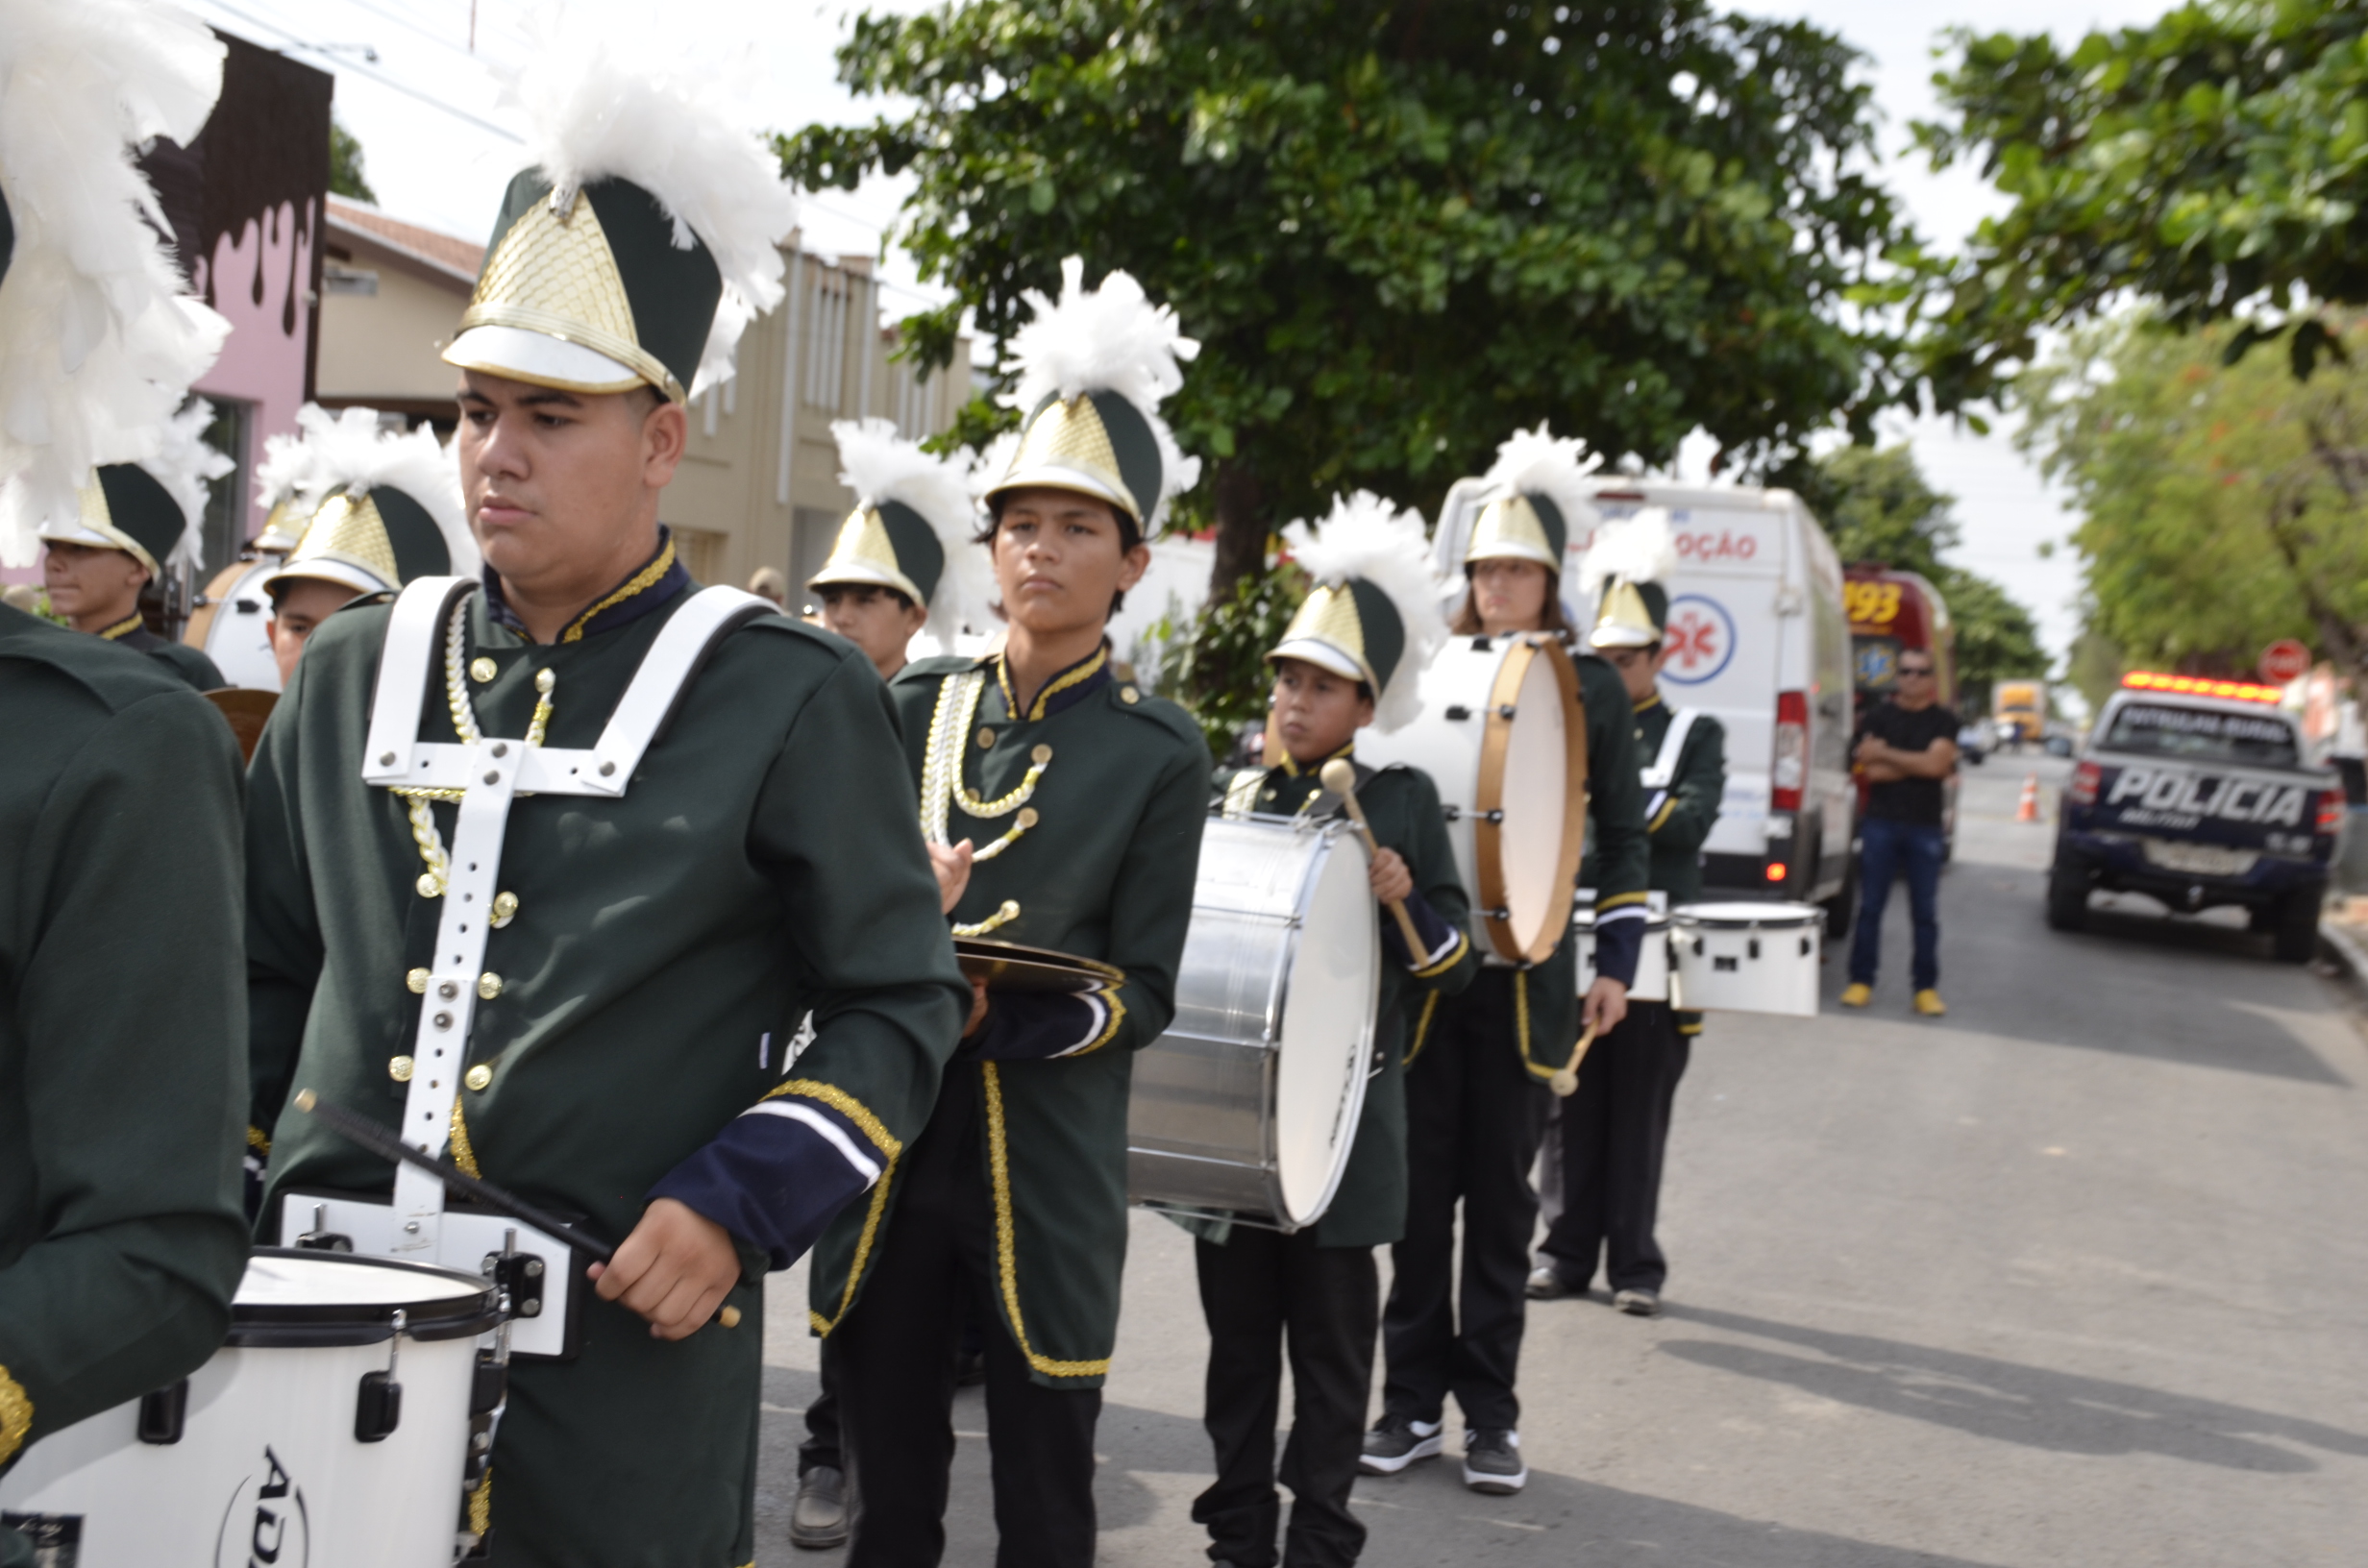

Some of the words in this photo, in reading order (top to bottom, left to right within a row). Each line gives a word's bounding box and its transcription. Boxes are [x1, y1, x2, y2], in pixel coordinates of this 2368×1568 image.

[1675, 531, 1757, 561] OÇÃO
[1843, 580, 1903, 623] 193
[247, 1442, 291, 1568] AD
